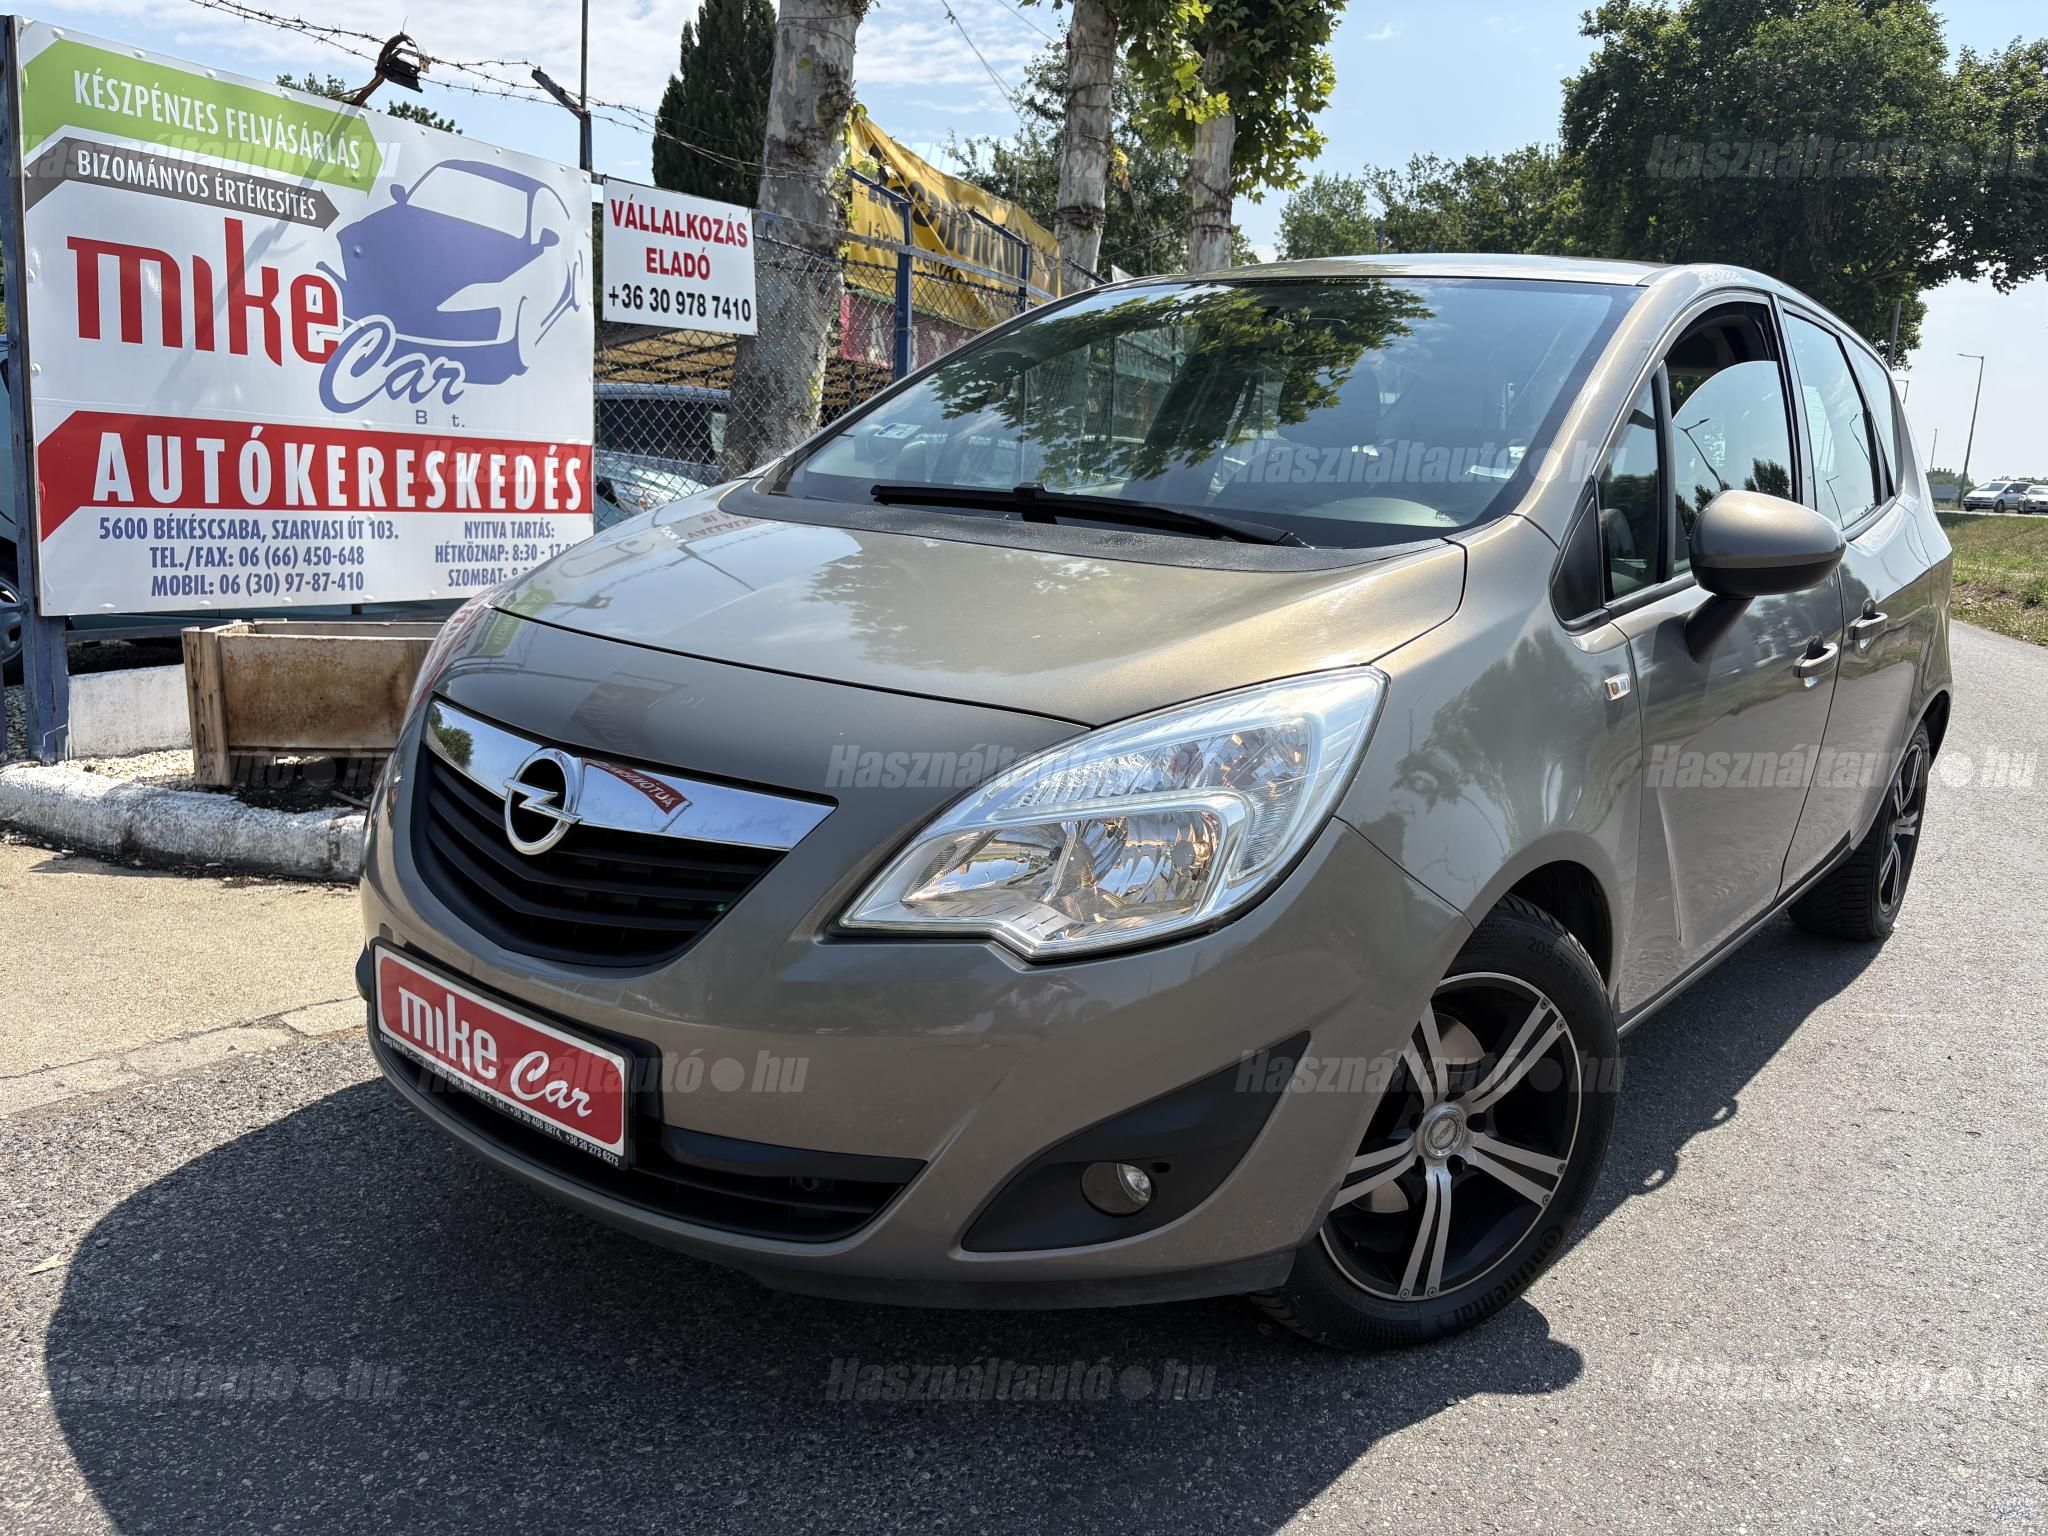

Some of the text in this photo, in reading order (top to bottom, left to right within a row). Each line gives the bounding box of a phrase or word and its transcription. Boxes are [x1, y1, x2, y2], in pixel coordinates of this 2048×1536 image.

[74, 68, 361, 169] KÉSZPÉNZES FELVÁSÁRLÁS
[78, 149, 317, 221] BIZOMÁNYOS ÉRTÉKESÍTÉS
[610, 194, 748, 249] VÁLLALKOZÁS
[646, 247, 711, 280] ELADÓ
[609, 283, 751, 322] +36 30 978 7410
[319, 319, 465, 414] Car
[93, 425, 582, 510] AUTÓKERESKEDÉS
[99, 513, 399, 543] 5600 BÉKÉSCSABA, SZARVASI ÚT 103.
[464, 517, 555, 540] NYITVA TARTÁS:
[150, 545, 365, 571] TEL./FAX: 06 (66) 450-648
[435, 541, 509, 563] HÉTKÖZNAP:
[512, 543, 538, 562] 8:30
[151, 571, 365, 597] MOBIL: 06 (30) 97-87-410
[510, 1050, 593, 1117] Car
